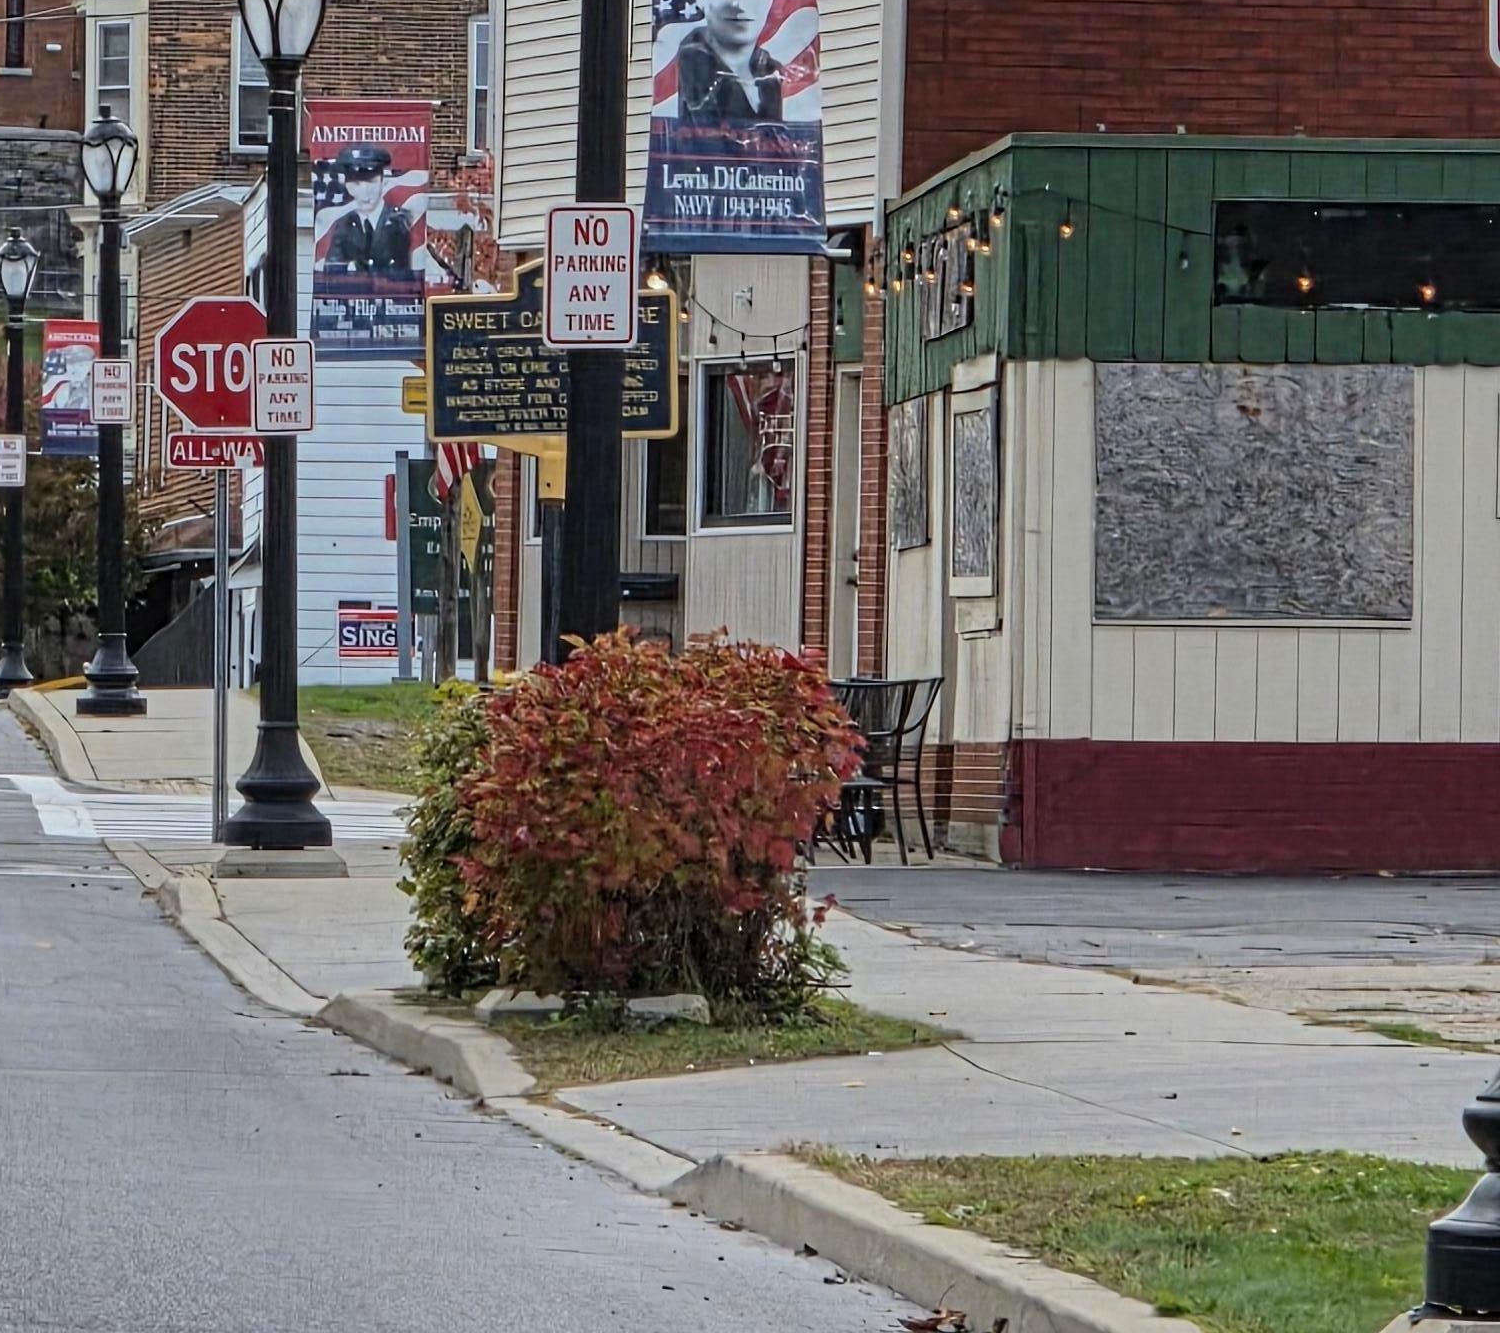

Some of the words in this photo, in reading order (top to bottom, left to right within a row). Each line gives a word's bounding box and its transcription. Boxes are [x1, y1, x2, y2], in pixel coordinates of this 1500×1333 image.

[312, 126, 425, 142] AMSTERDAM
[663, 164, 709, 189] Lewis
[713, 166, 805, 191] DiCaterino
[675, 195, 714, 215] NAVY
[574, 218, 609, 246] NO
[555, 255, 626, 272] PARKING
[569, 285, 610, 302] ANY
[443, 312, 511, 330] SWEET
[565, 314, 615, 331] TIME
[271, 348, 295, 367] NO
[104, 365, 121, 378] NO
[171, 342, 251, 393] STO
[259, 373, 308, 384] PARKING
[269, 393, 298, 404] ANY
[268, 411, 301, 423] TIME
[342, 625, 396, 647] SING
